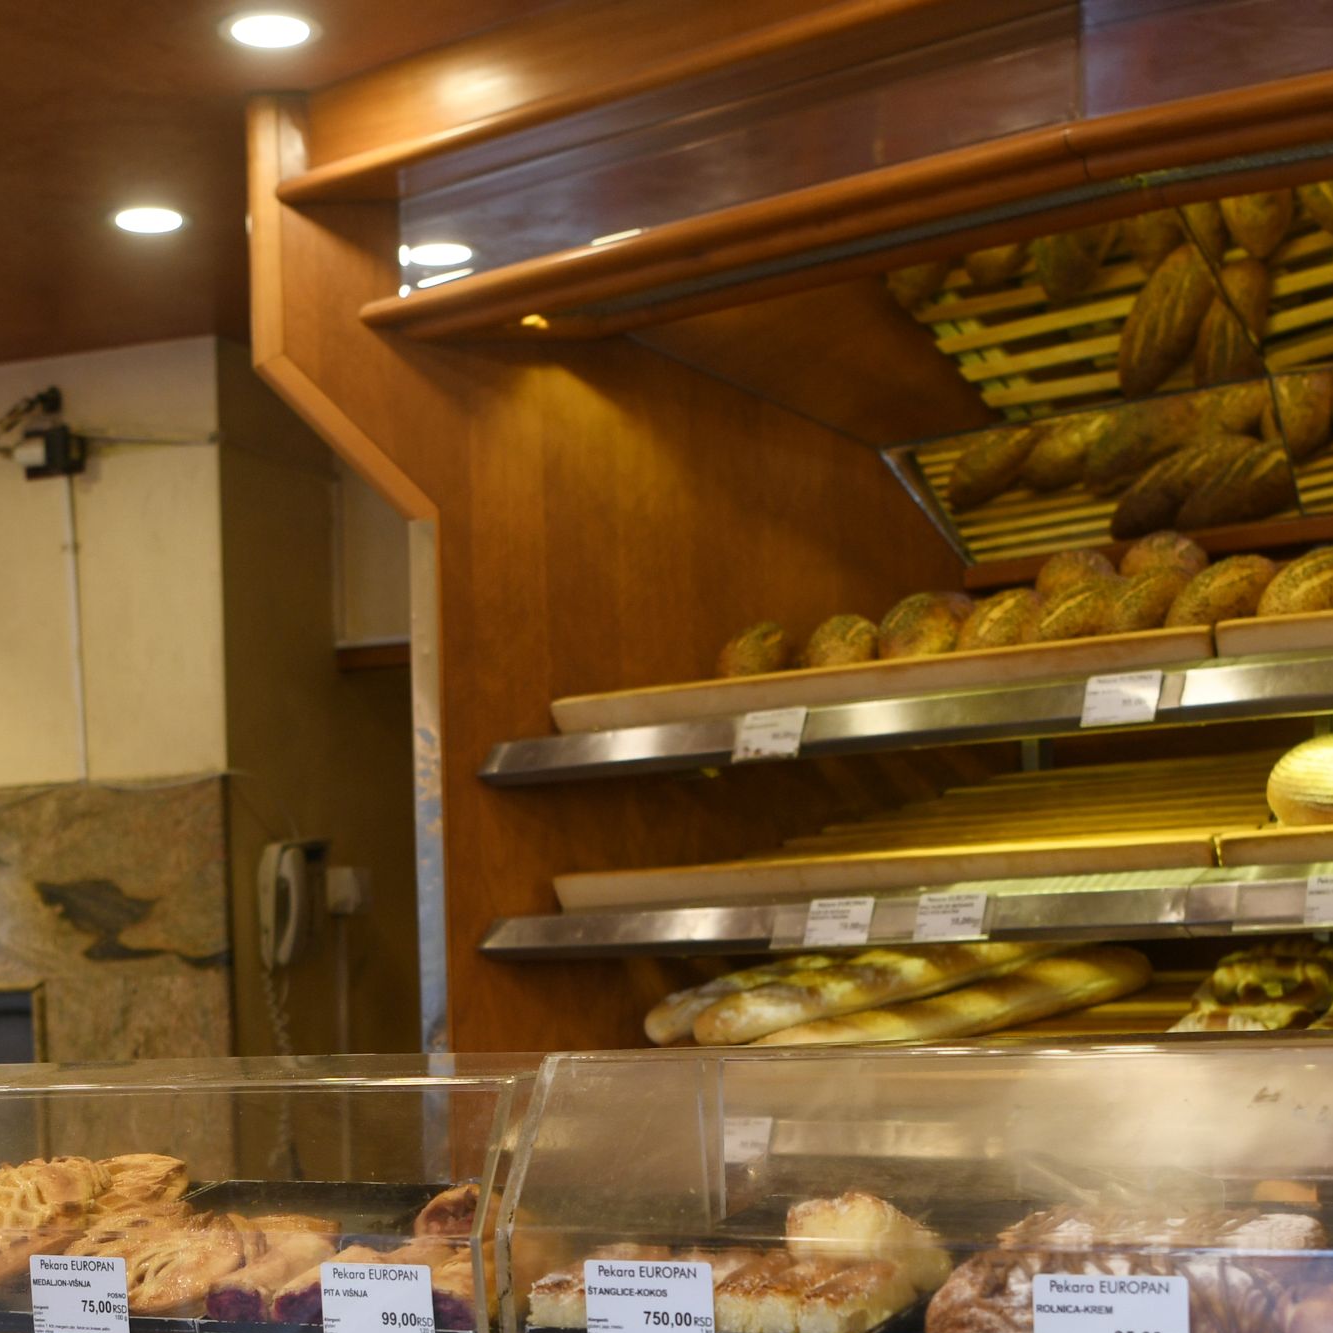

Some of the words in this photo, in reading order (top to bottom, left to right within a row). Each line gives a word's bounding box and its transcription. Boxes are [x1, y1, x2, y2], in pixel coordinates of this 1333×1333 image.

[40, 1259, 68, 1270] Pekara
[71, 1260, 114, 1271] EUROPAN
[598, 1265, 635, 1277] Pekara
[639, 1266, 697, 1278] EUROPAN
[333, 1267, 365, 1280] Pekara
[369, 1269, 418, 1281] EUROPAN
[324, 1288, 340, 1296] PITA
[342, 1288, 368, 1298] VIŠNJA
[1049, 1280, 1094, 1294] Pekara
[1100, 1281, 1169, 1294] EUROPAN
[644, 1311, 692, 1328] 750,00
